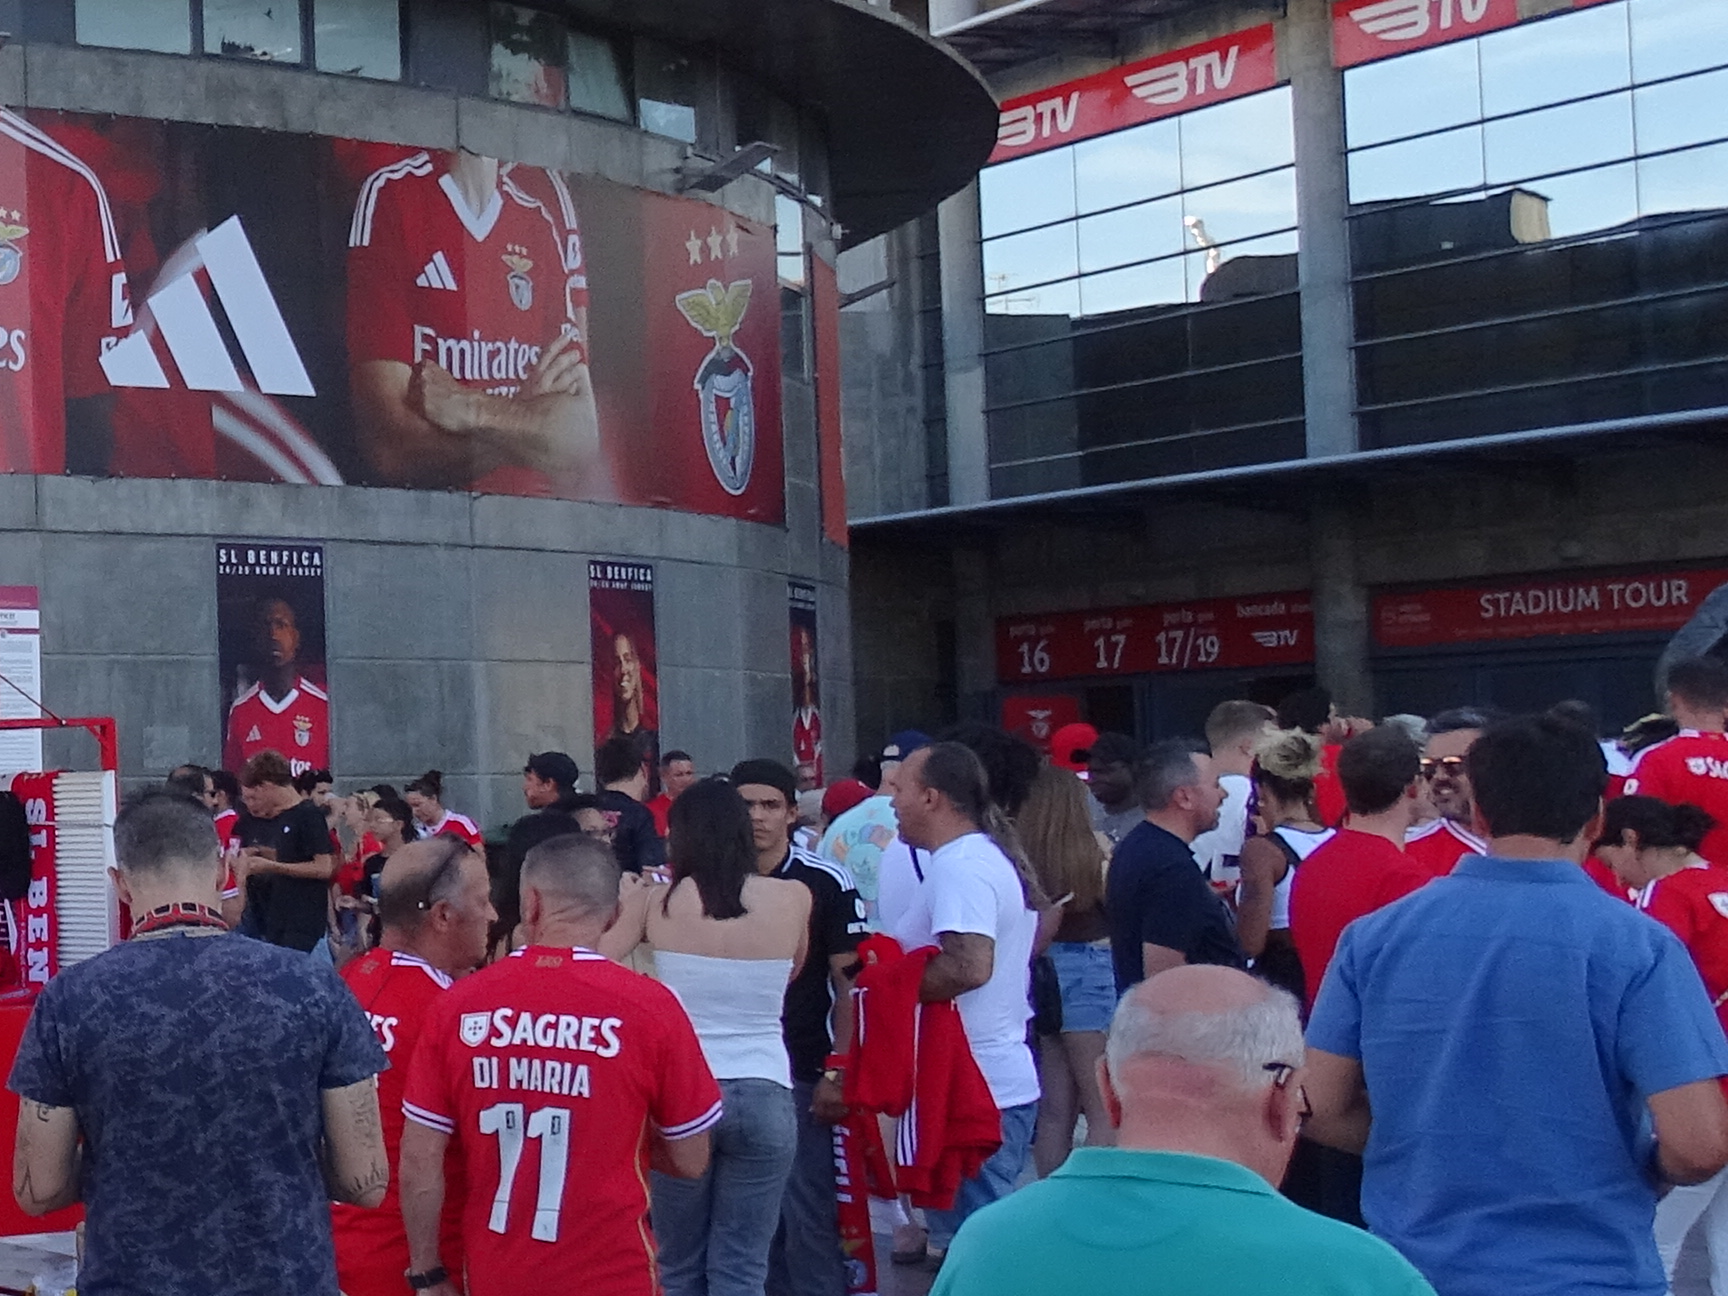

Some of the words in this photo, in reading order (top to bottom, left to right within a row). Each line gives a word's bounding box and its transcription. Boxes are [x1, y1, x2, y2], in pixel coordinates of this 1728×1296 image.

[219, 549, 241, 566] SL
[246, 549, 323, 567] BENFICA
[1479, 587, 1600, 618] STADIUM
[1608, 579, 1689, 611] TOUR
[1018, 639, 1051, 675] 16
[1094, 633, 1126, 670] 17
[1155, 627, 1221, 669] 17/19
[489, 1007, 624, 1058] SAGRES
[472, 1056, 499, 1089] DI
[508, 1056, 591, 1099] MARIA
[478, 1103, 571, 1244] 11
